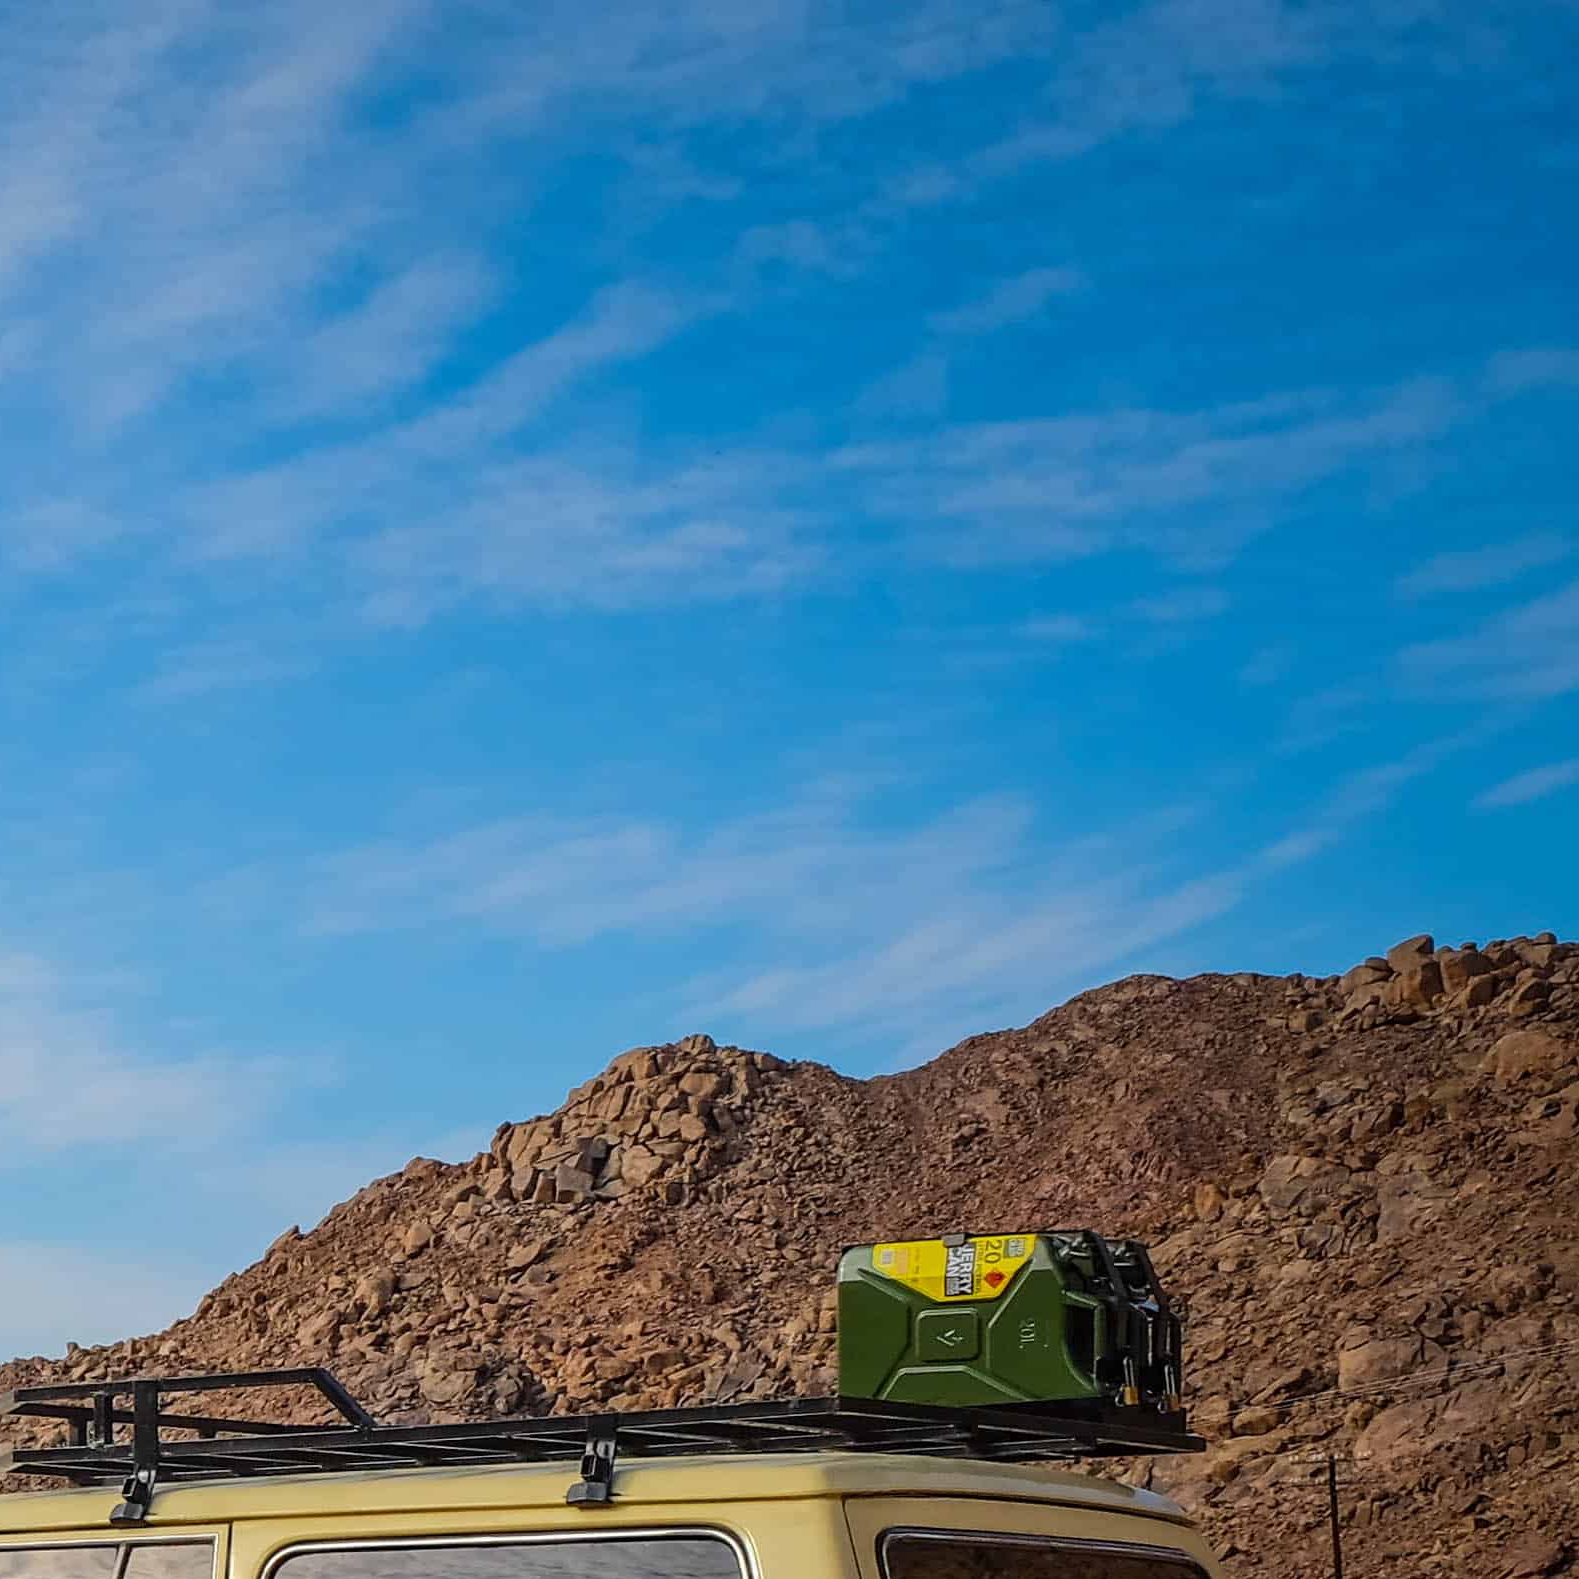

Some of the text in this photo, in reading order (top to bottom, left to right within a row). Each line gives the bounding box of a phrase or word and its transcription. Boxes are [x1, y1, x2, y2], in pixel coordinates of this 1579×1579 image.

[946, 1247, 961, 1278] CAN
[985, 1240, 1002, 1264] 20
[959, 1244, 974, 1294] JERRY
